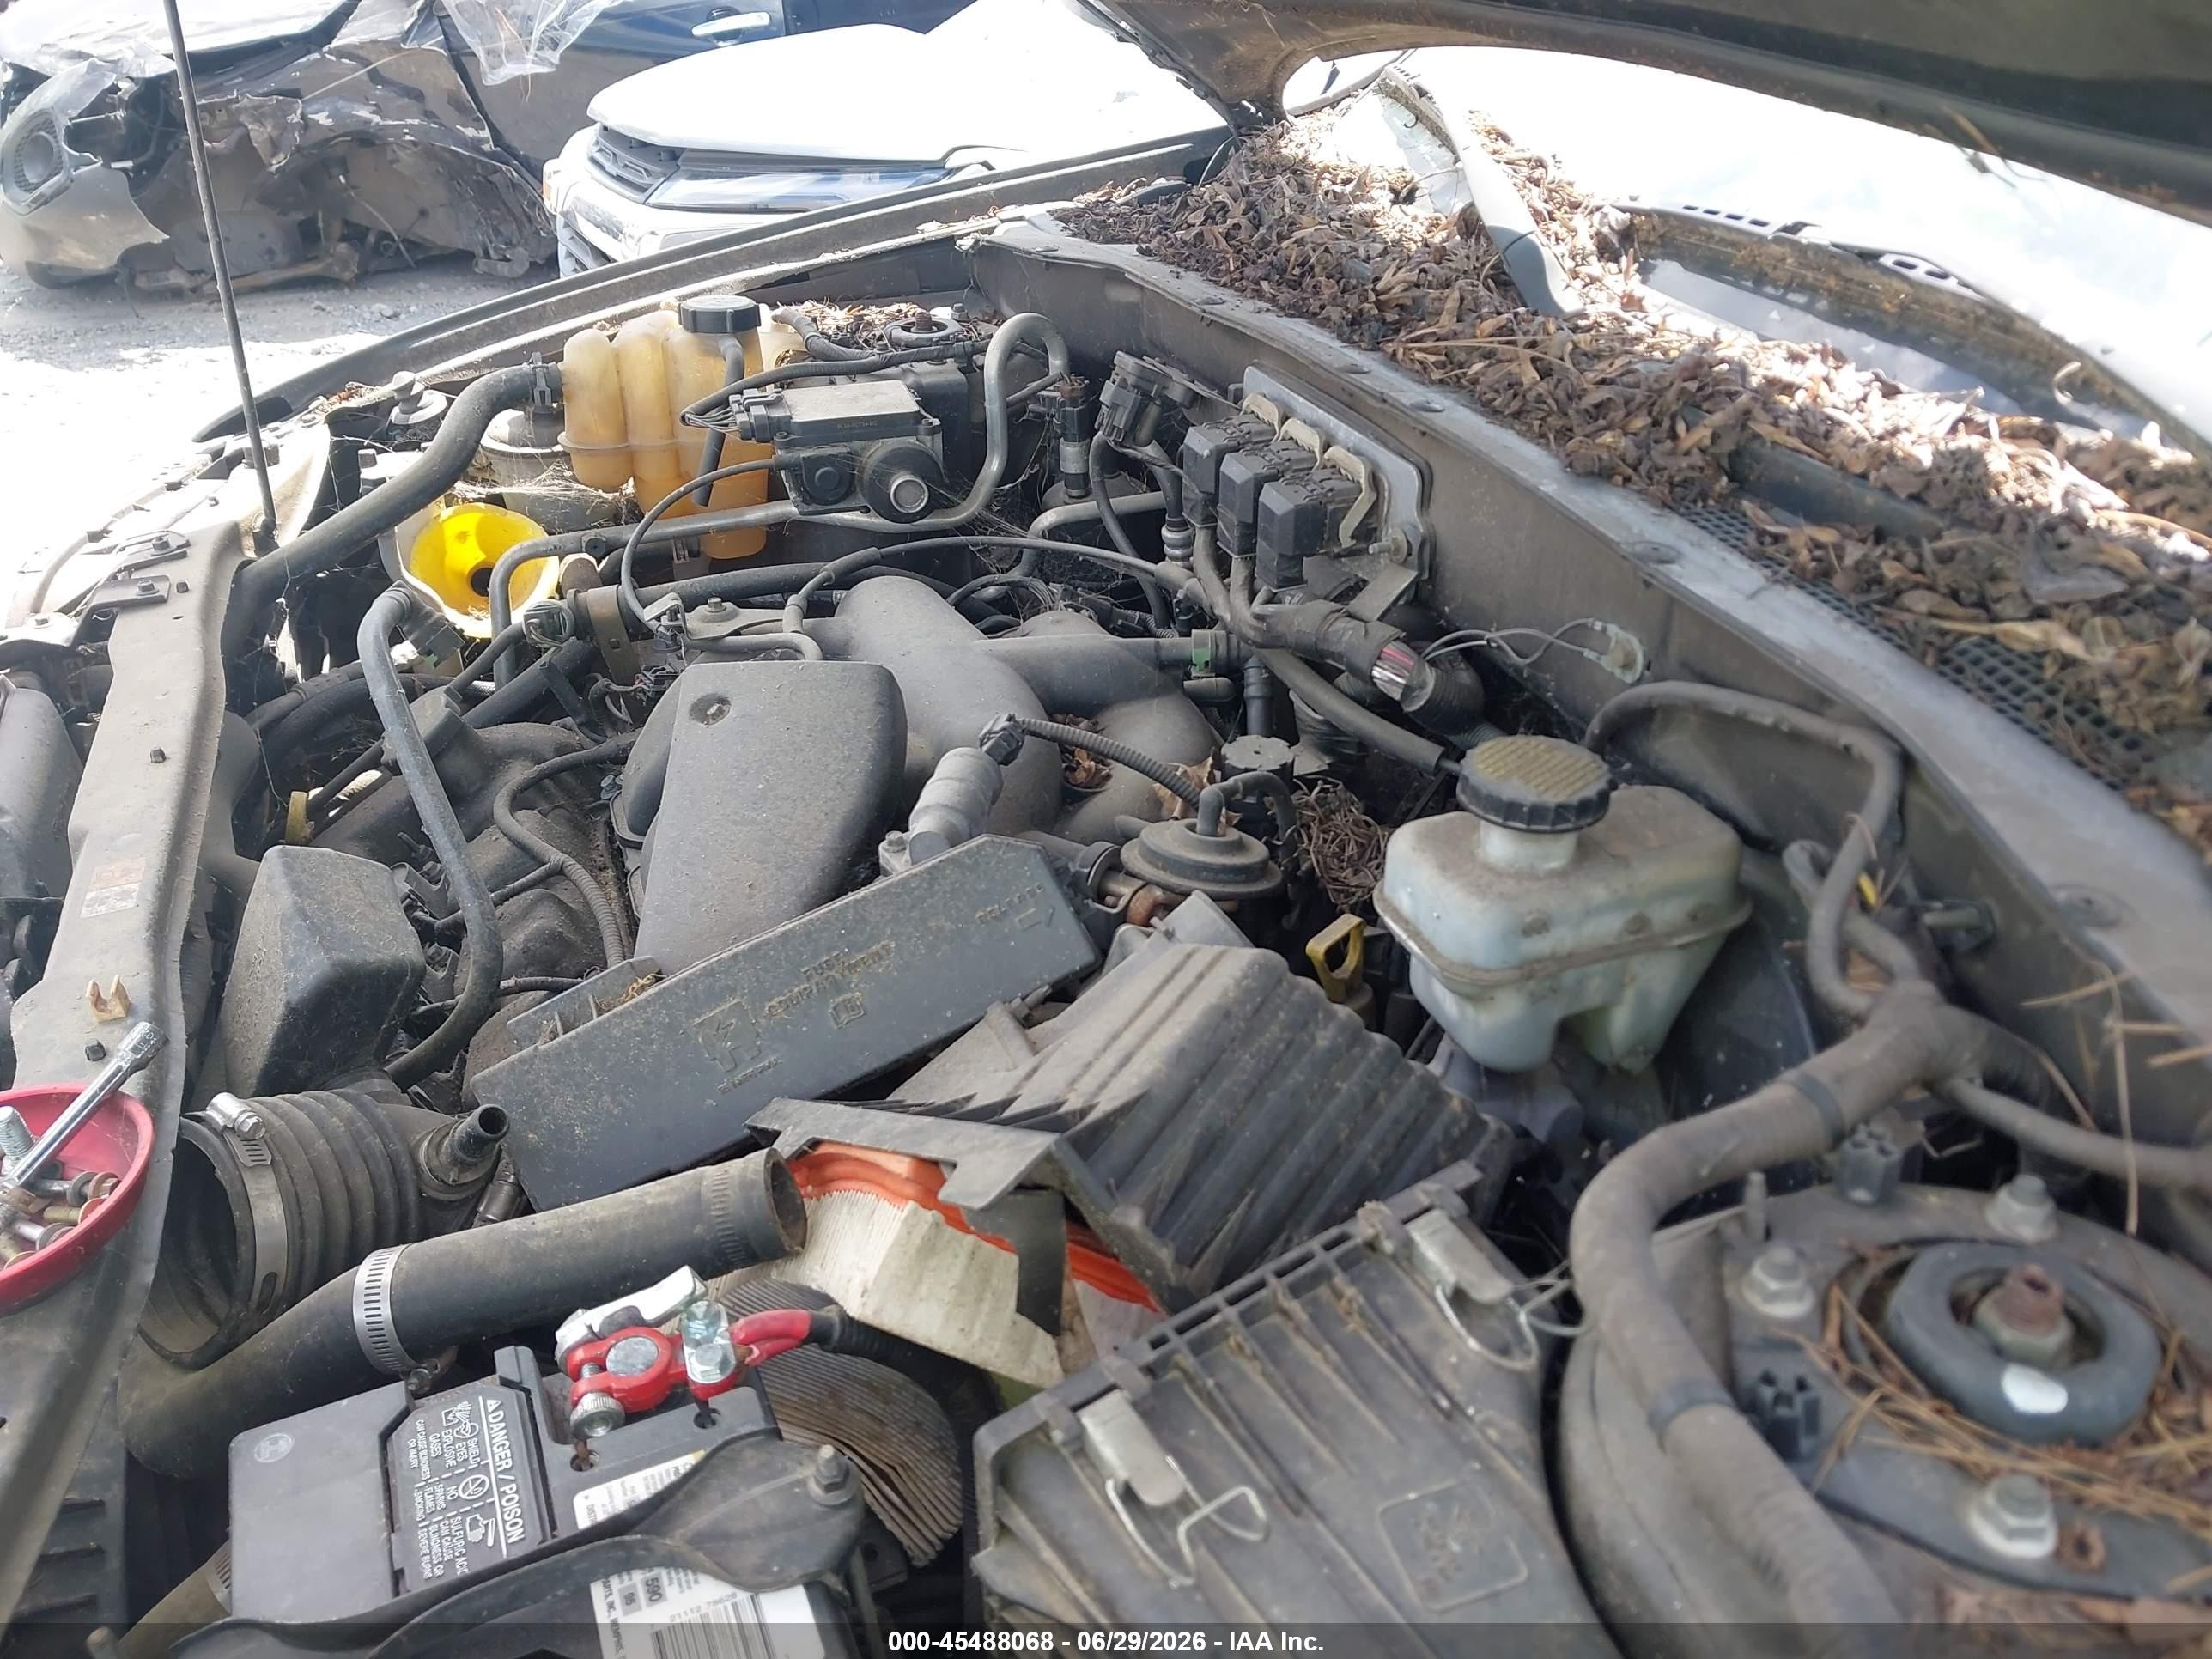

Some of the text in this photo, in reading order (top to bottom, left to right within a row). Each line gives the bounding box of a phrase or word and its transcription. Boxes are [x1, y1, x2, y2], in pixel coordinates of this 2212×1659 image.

[802, 951, 846, 981] FUSE
[406, 1438, 415, 1449] OR
[416, 1431, 426, 1450] CAUSE
[428, 1433, 441, 1457] GASES
[441, 1429, 456, 1468] EXPLOSIVE
[455, 1443, 465, 1461] EYES
[466, 1437, 480, 1464] SHIELD
[487, 1411, 512, 1471] DANGER
[418, 1449, 430, 1480] BLINDNESS
[446, 1486, 458, 1499] NO
[499, 1483, 524, 1543] POISON
[428, 1524, 443, 1576] BLINDNESS OR
[440, 1521, 454, 1560] CAN CAUSE
[451, 1517, 465, 1555] SULFURIC
[417, 1528, 432, 1579] SEVERE BURNS
[646, 1577, 662, 1602] 590
